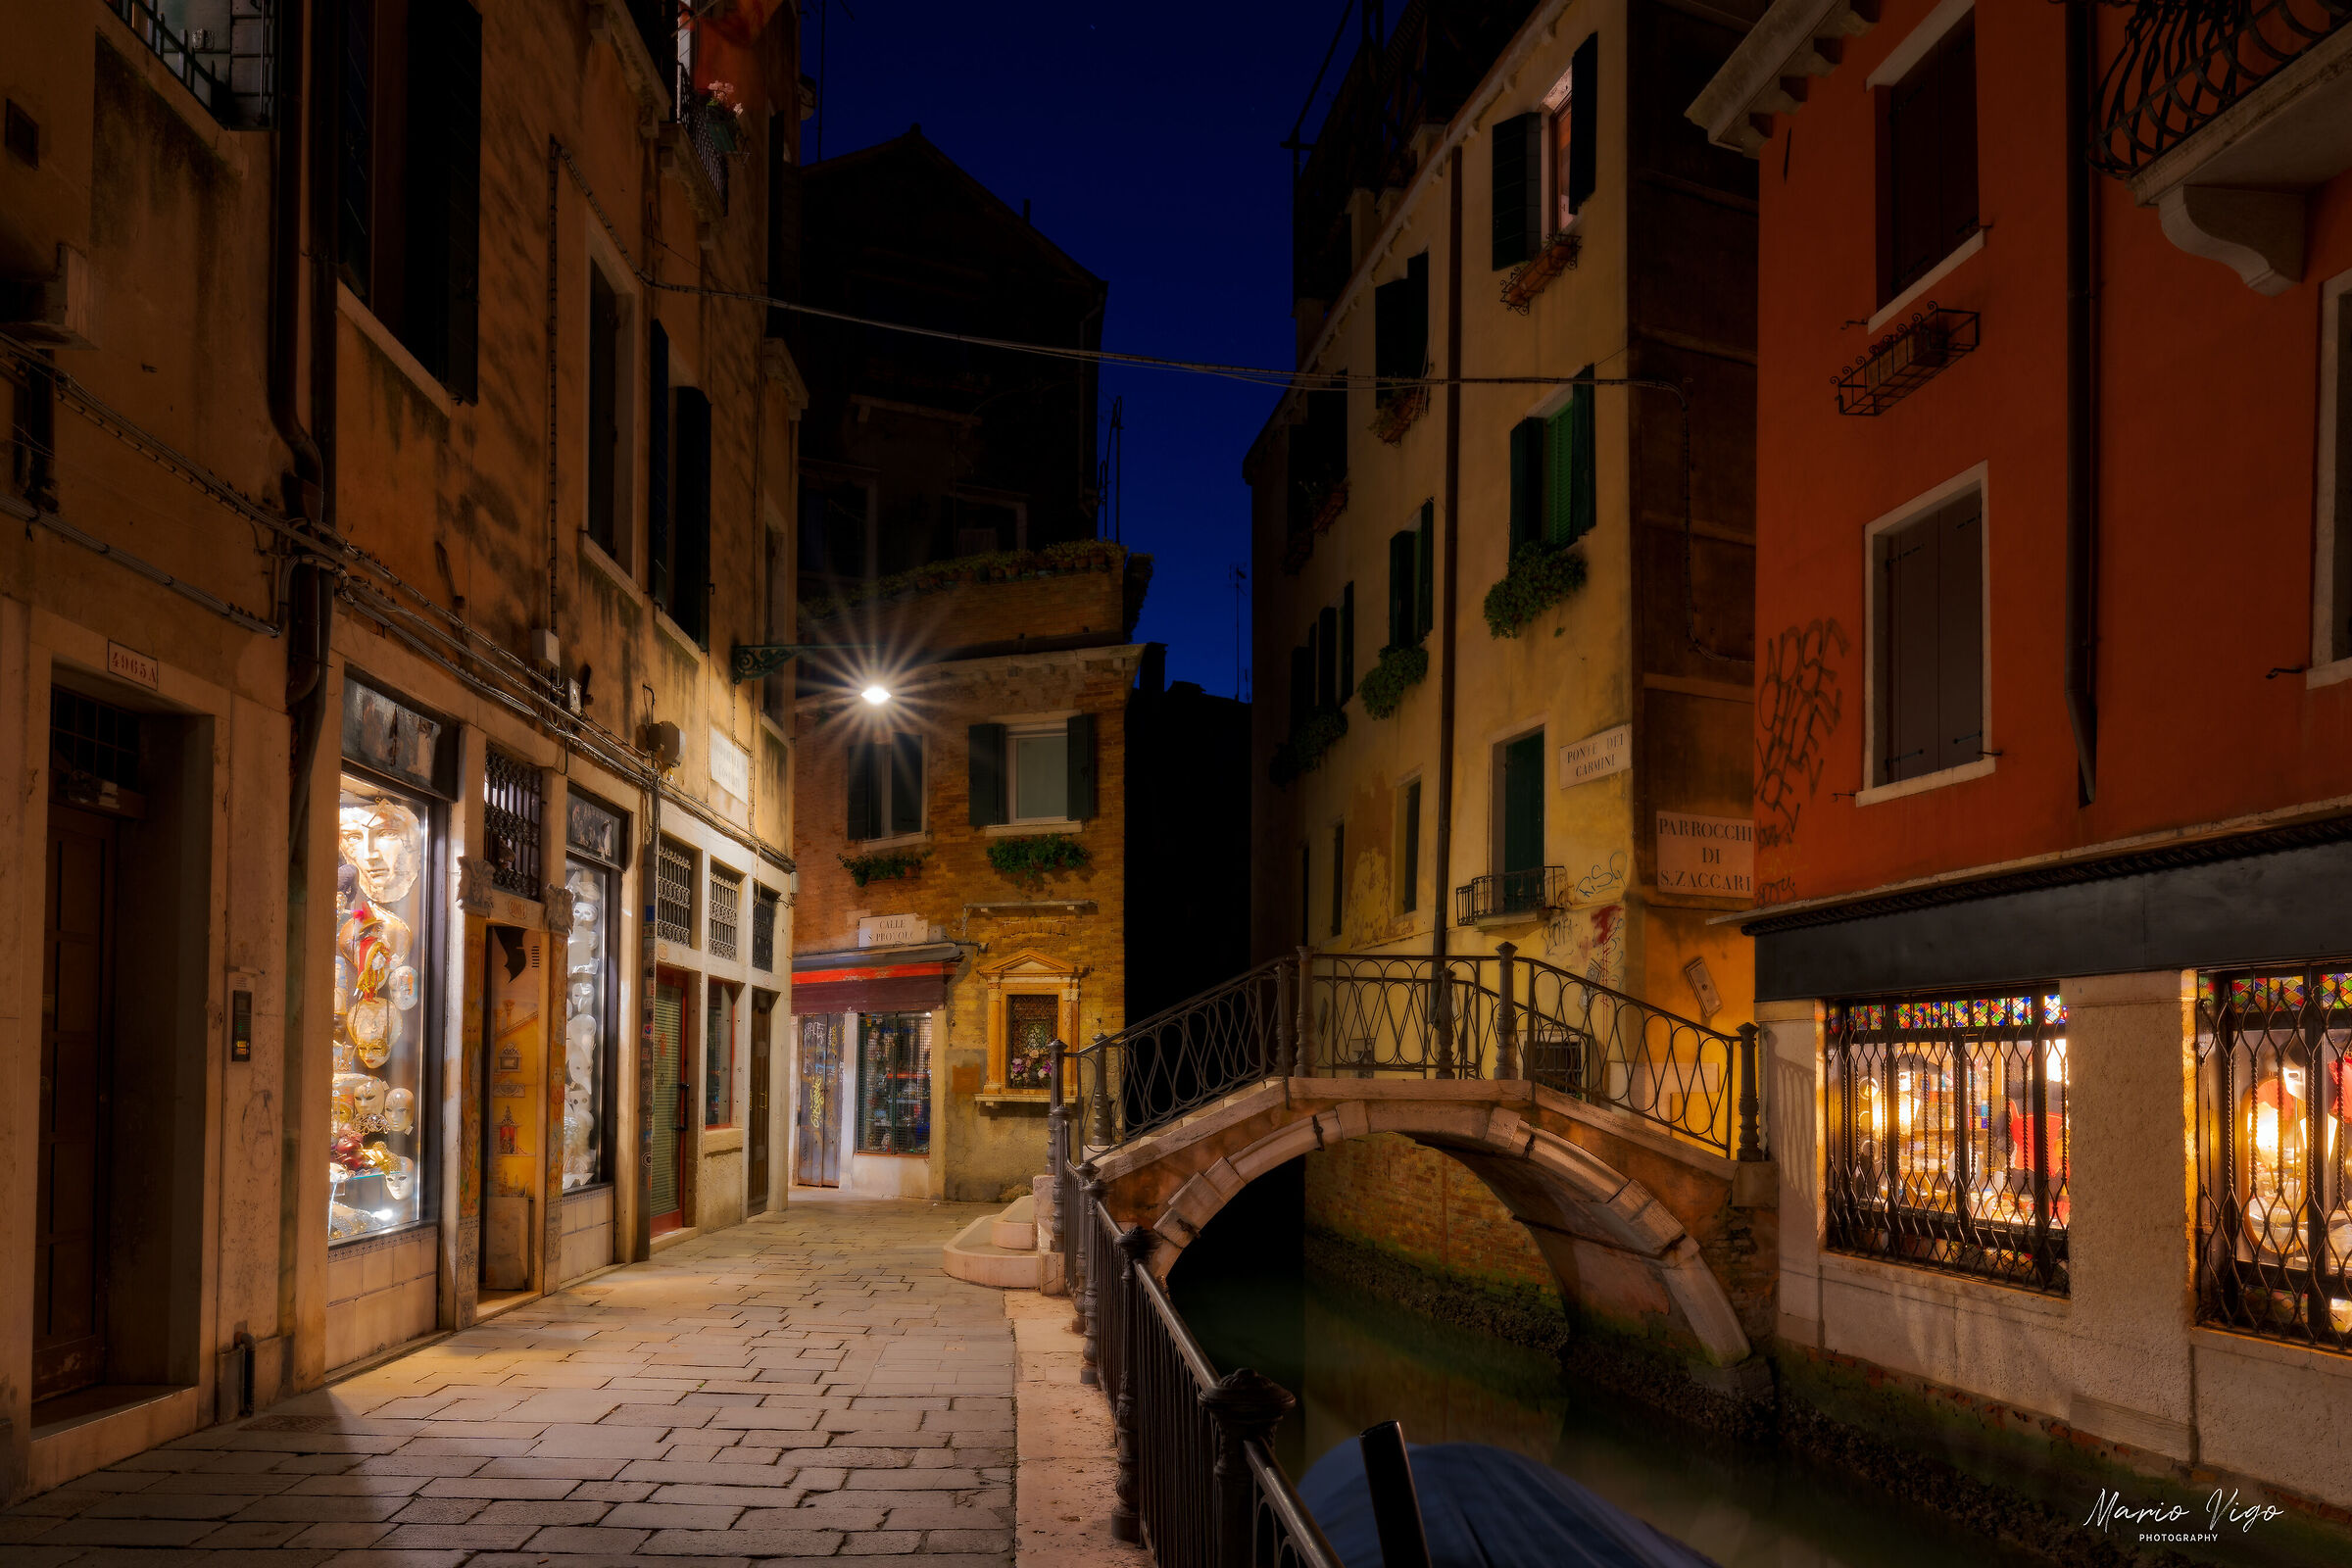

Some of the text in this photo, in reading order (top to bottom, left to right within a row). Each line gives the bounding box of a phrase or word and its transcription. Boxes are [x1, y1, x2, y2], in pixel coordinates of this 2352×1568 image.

[112, 652, 157, 683] 4965A
[1567, 732, 1624, 764] PONTE DEI
[1575, 754, 1616, 777] CARMINI
[1702, 847, 1721, 864] DI
[879, 919, 906, 929] CALLE
